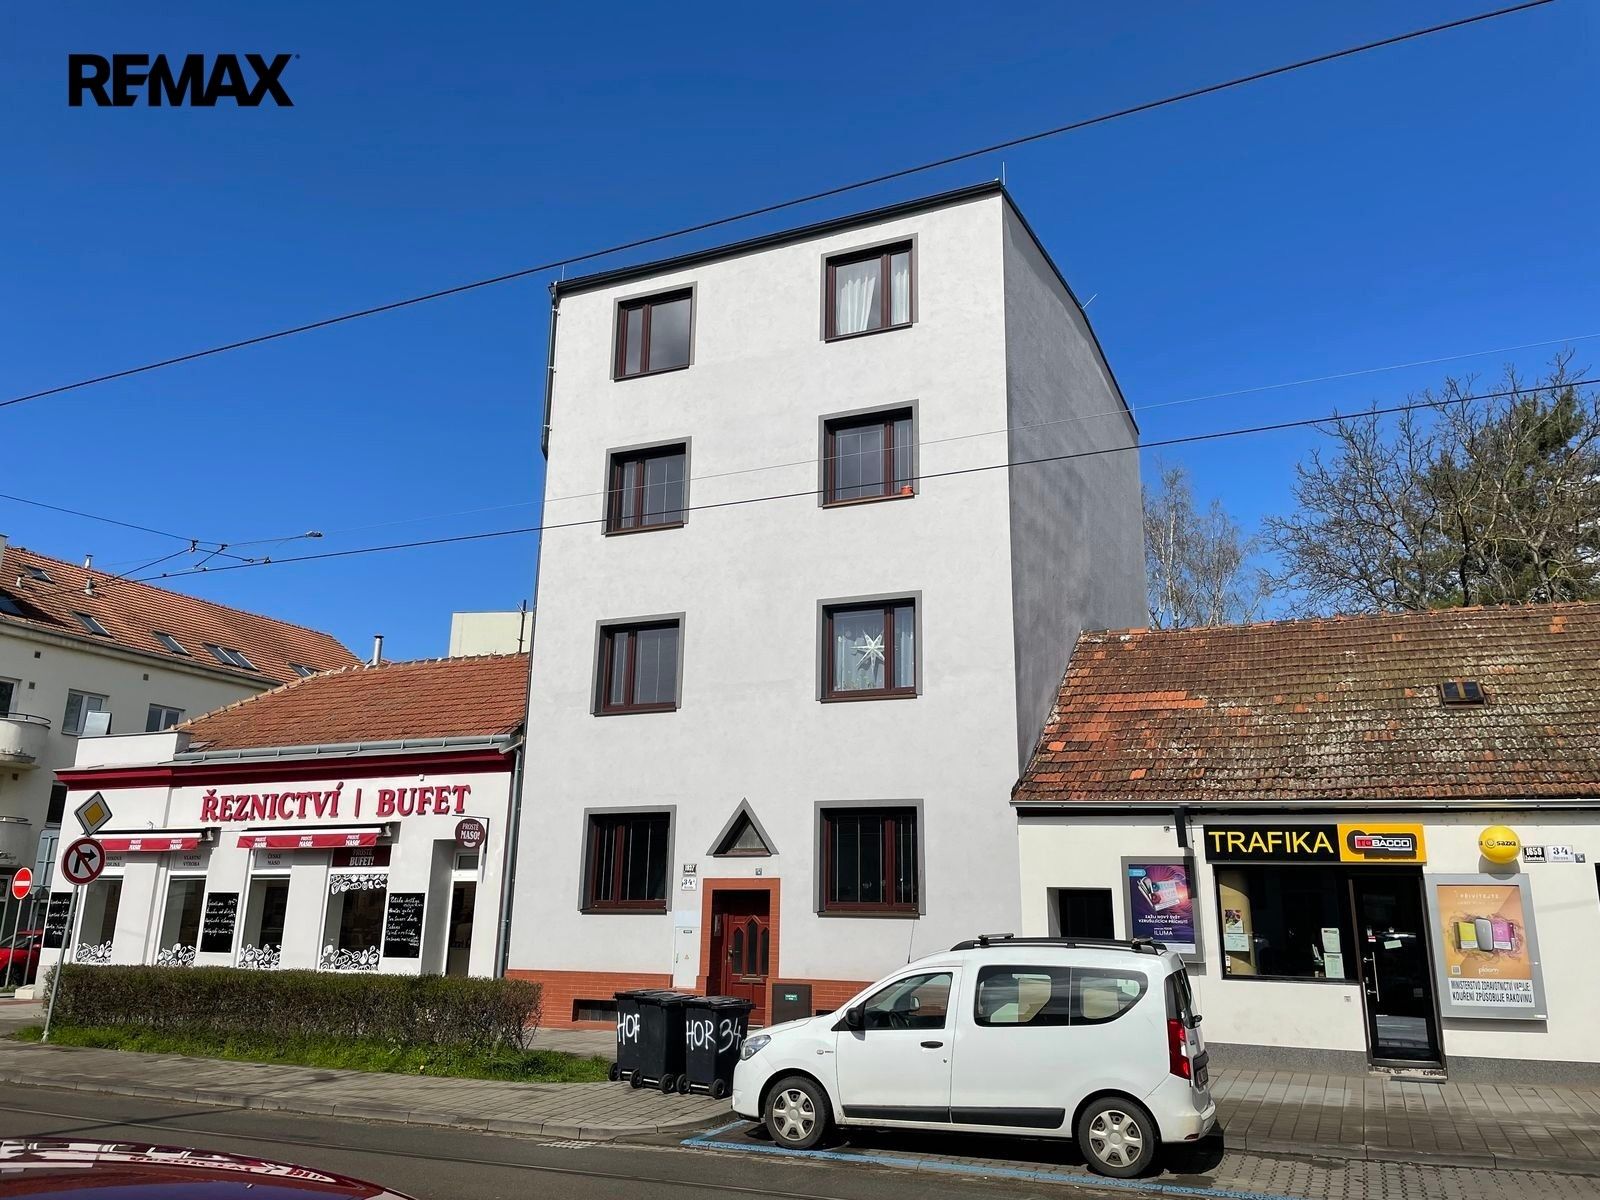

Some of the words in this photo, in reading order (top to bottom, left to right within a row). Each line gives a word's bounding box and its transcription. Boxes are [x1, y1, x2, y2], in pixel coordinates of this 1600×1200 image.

[200, 781, 344, 822] ŘEZNICTVÍ
[376, 784, 472, 818] BUFET
[460, 830, 481, 840] MASO!
[1208, 831, 1335, 854] TRAFIKA
[349, 857, 375, 866] BUFET!
[1505, 993, 1533, 1003] RAKOVINU
[686, 1019, 716, 1051] HOR
